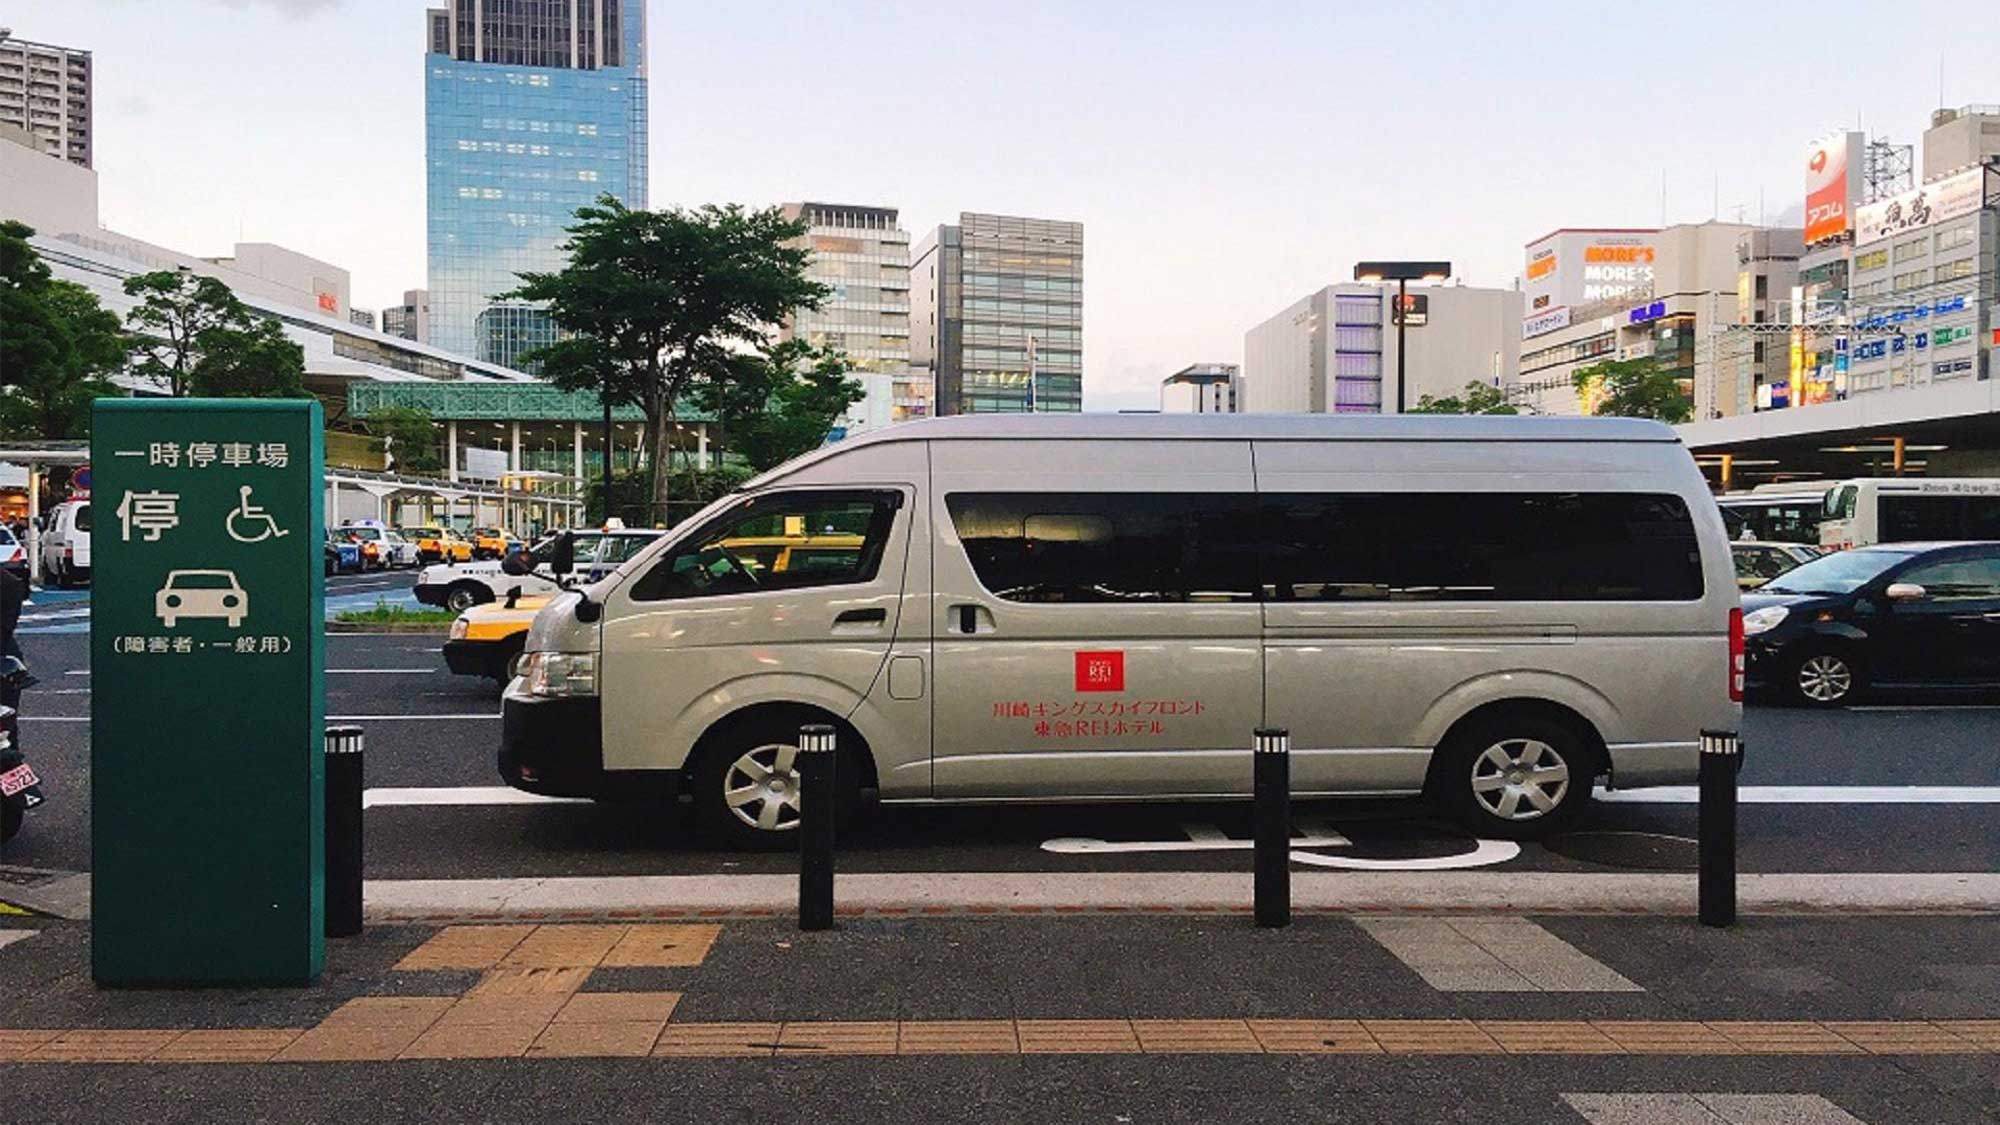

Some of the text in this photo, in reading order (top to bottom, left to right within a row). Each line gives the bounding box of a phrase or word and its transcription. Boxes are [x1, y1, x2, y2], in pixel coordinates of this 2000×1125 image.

[1807, 201, 1843, 227] アコム
[1586, 247, 1655, 263] MORE'S
[1586, 266, 1654, 281] MORE'S
[114, 442, 289, 468] 一時停車場
[116, 490, 180, 541] 停
[993, 701, 1206, 718] 川崎キングスカイフロント
[1034, 720, 1166, 737] 東急REIホテル
